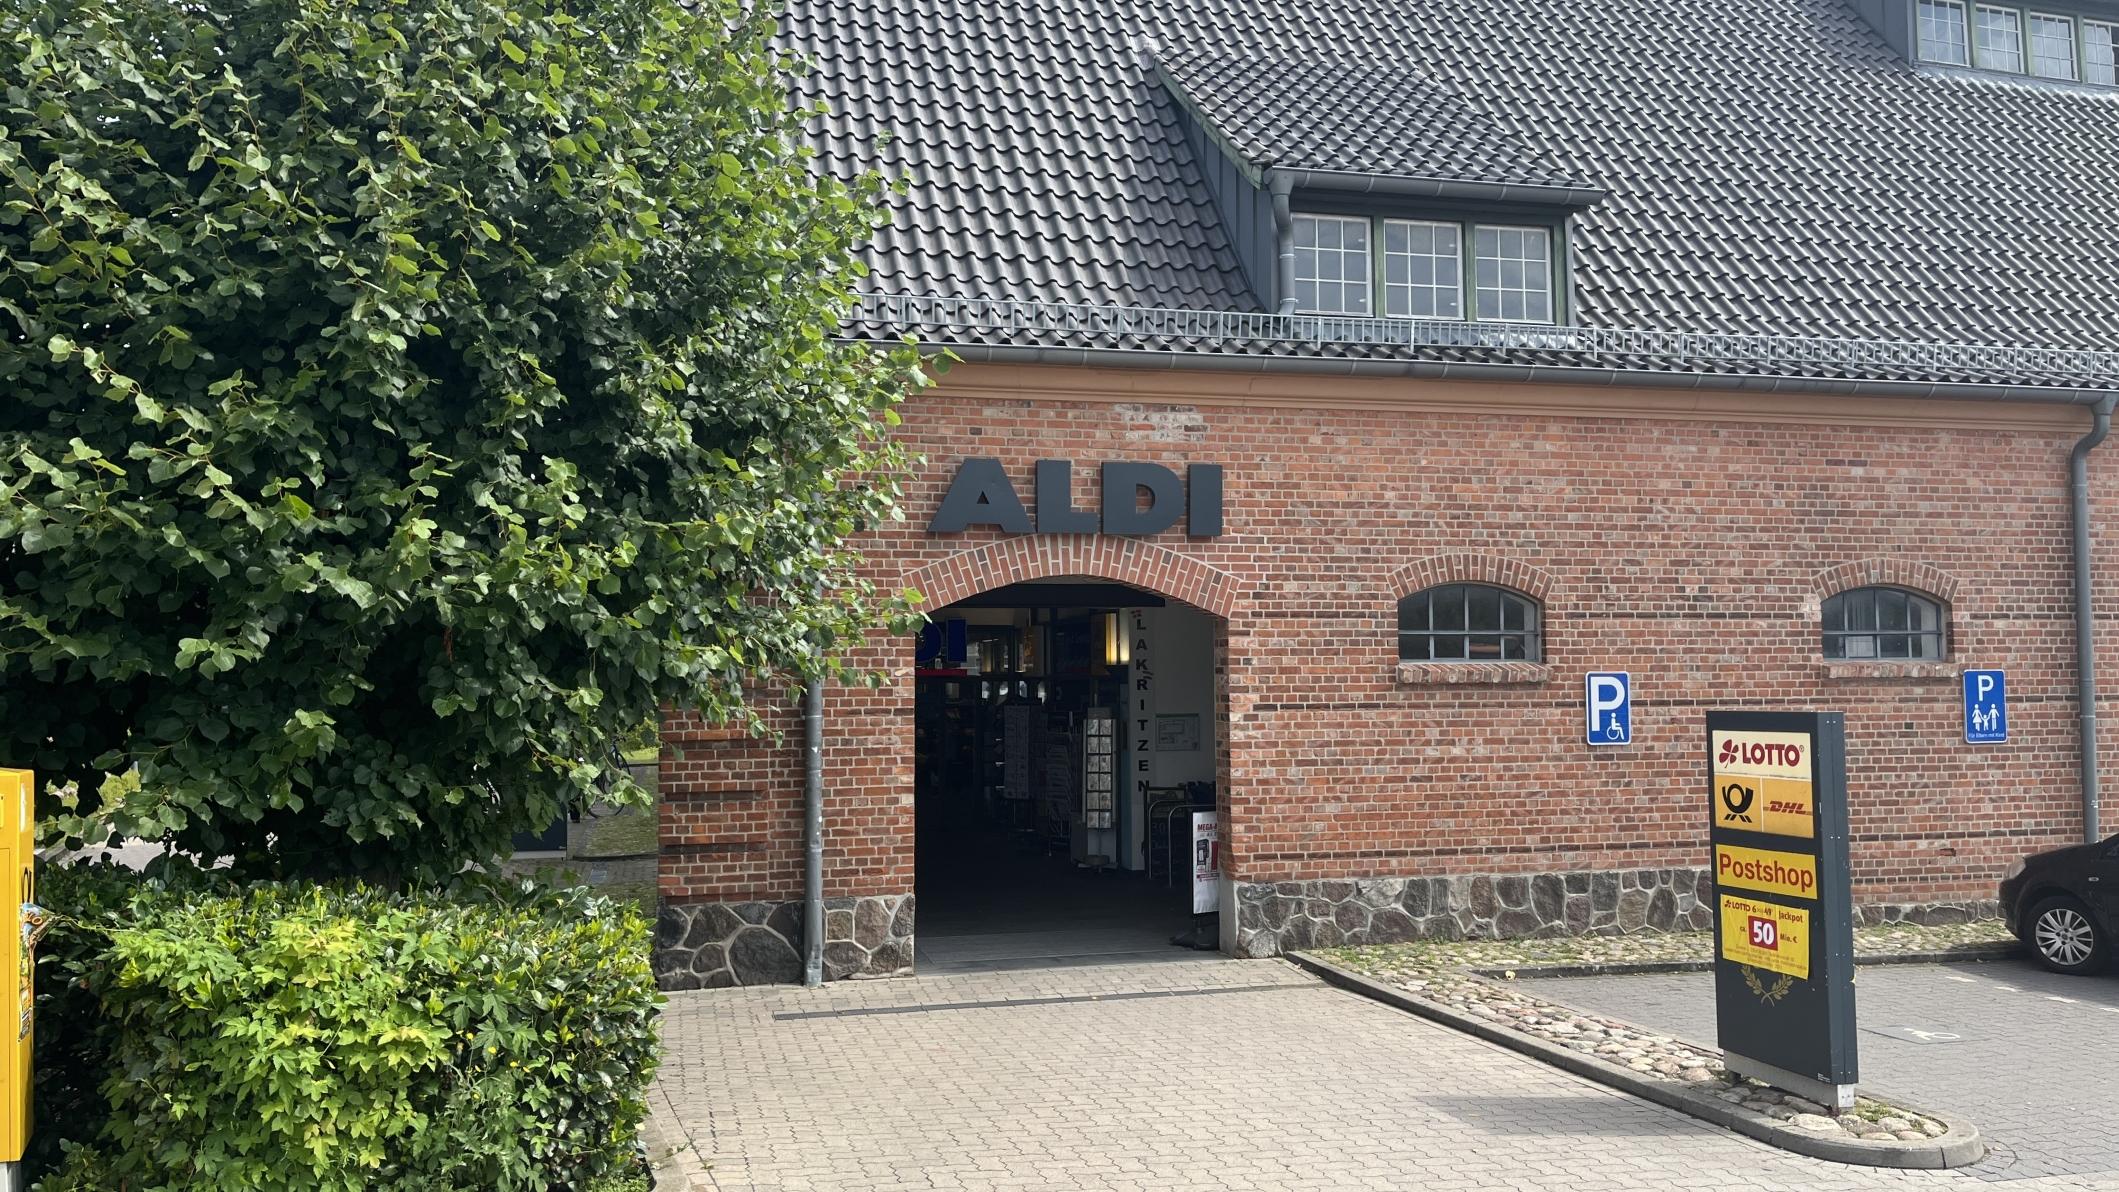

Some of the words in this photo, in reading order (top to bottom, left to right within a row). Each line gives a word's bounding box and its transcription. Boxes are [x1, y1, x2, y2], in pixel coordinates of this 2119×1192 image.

[928, 458, 1222, 537] ALDI
[1977, 674, 1994, 701] P
[1136, 618, 1149, 792] LAKRITZEN
[1591, 676, 1625, 731] P
[1769, 800, 1807, 814] DHL
[1719, 853, 1813, 892] Postshop
[1732, 901, 1751, 912] LOTTO
[1778, 911, 1803, 923] Jackpot
[1753, 920, 1775, 945] 50
[1780, 933, 1792, 943] Mio.
[1793, 935, 1798, 944] €
